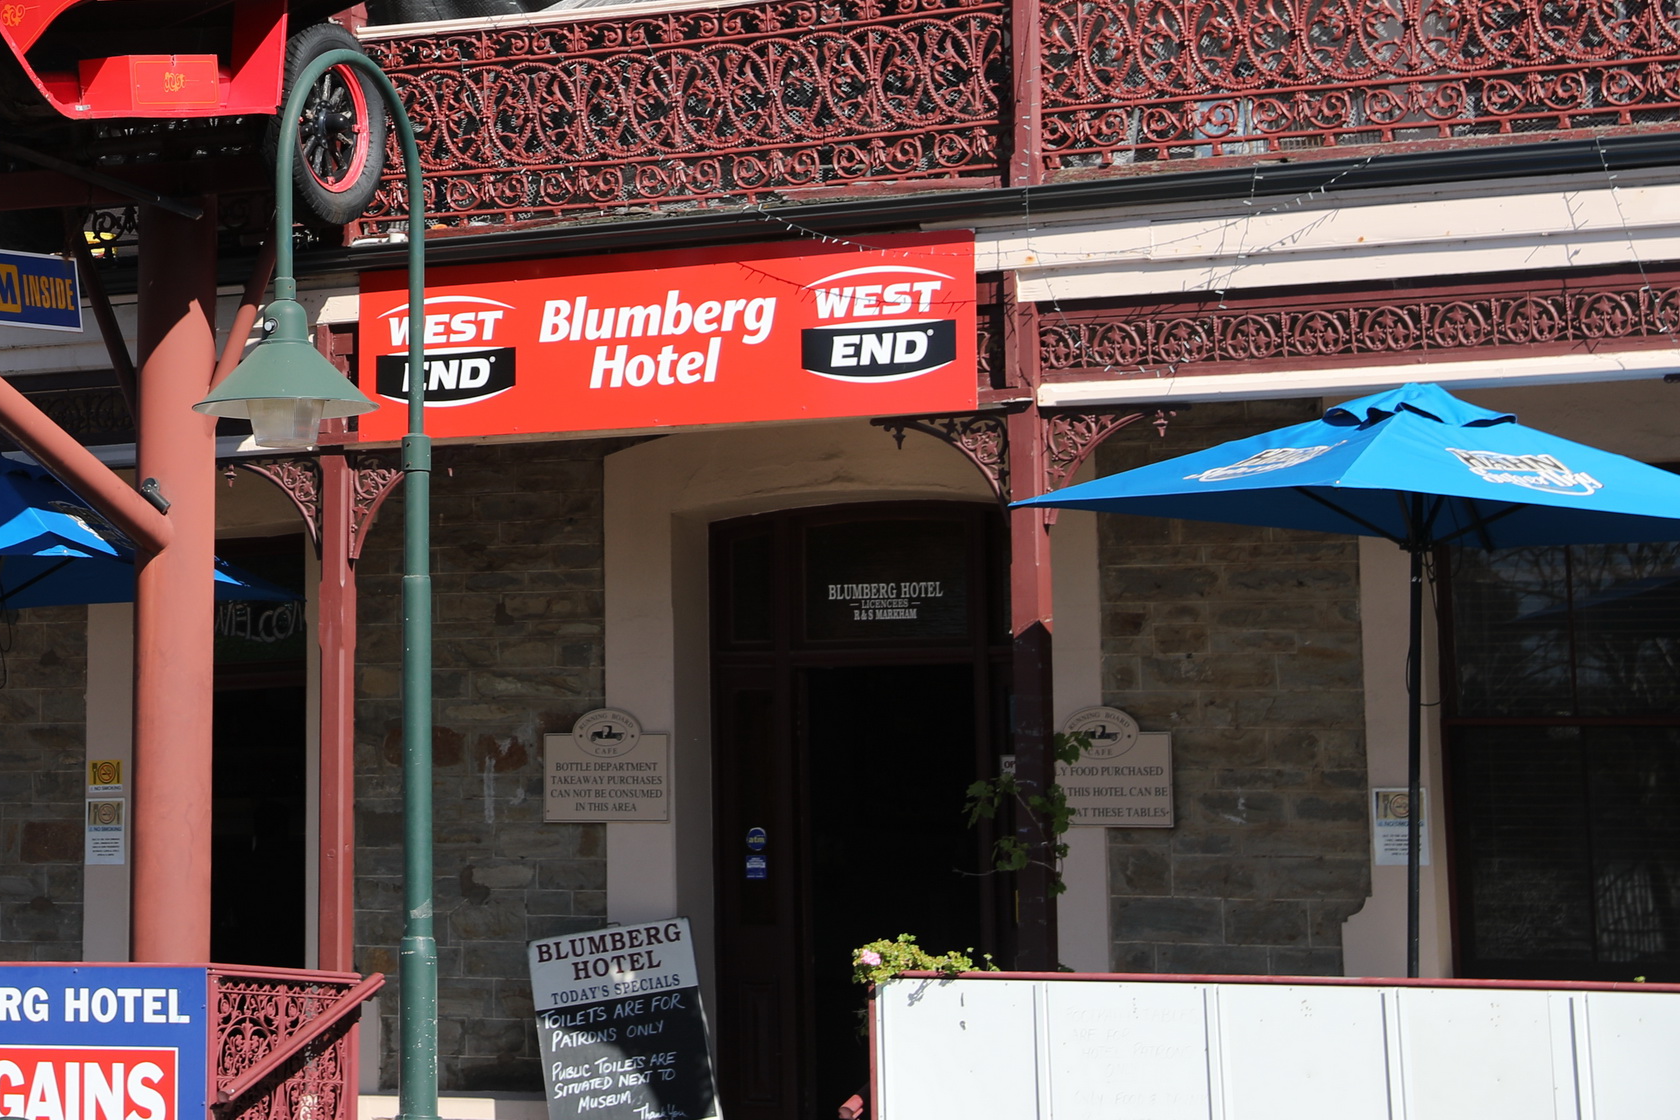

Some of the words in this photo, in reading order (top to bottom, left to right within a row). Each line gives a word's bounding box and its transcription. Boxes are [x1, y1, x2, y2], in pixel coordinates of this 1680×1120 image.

[23, 274, 75, 311] INSIDE
[817, 280, 943, 319] WEST
[389, 310, 504, 346] WEST
[539, 290, 776, 345] Blumberg
[589, 336, 723, 389] Hotel
[830, 330, 929, 367] END
[828, 583, 897, 600] BLUMBERG
[900, 581, 943, 598] HOTEL
[861, 599, 909, 609] LICENCEES
[875, 608, 917, 620] MARKHAM
[555, 762, 592, 772] BOTTLE
[593, 762, 658, 772] DEPARTMENT
[1087, 748, 1113, 756] CAFE
[551, 776, 605, 785] TAKEAWAY
[607, 776, 662, 785] PURCHASES
[1070, 766, 1099, 776] FOOD
[1101, 766, 1164, 776] PURCHASED
[550, 789, 570, 798] CAN
[572, 789, 592, 798] NOT
[594, 789, 607, 798] BE
[608, 789, 662, 798] CONSUMED
[575, 802, 585, 811] IN
[588, 802, 609, 811] THIS
[611, 802, 637, 811] AREA
[1068, 787, 1090, 797] THIS
[1093, 787, 1127, 797] HOTEL
[1129, 787, 1152, 797] CAN
[1154, 787, 1168, 797] BE
[1075, 808, 1089, 817] AT
[1091, 808, 1124, 817] THESE
[536, 923, 682, 963] BLUMBERG
[572, 949, 662, 981] HOTEL
[551, 985, 609, 1005] TODAY'S
[614, 973, 681, 996] SPECIALS
[64, 987, 190, 1024] HOTEL
[541, 1007, 607, 1029] TOILETS
[613, 999, 644, 1019] ARE
[651, 993, 686, 1012] FOR
[552, 1028, 617, 1052] PATRONS
[626, 1020, 664, 1038] ONLY
[552, 1061, 592, 1081] PUBLIC
[594, 1056, 646, 1074] TOILETS
[649, 1051, 677, 1067] ARE
[553, 1076, 613, 1099] SITUATED
[618, 1071, 653, 1088] NEXT
[658, 1068, 676, 1081] TO
[577, 1090, 632, 1114] MUSEUM
